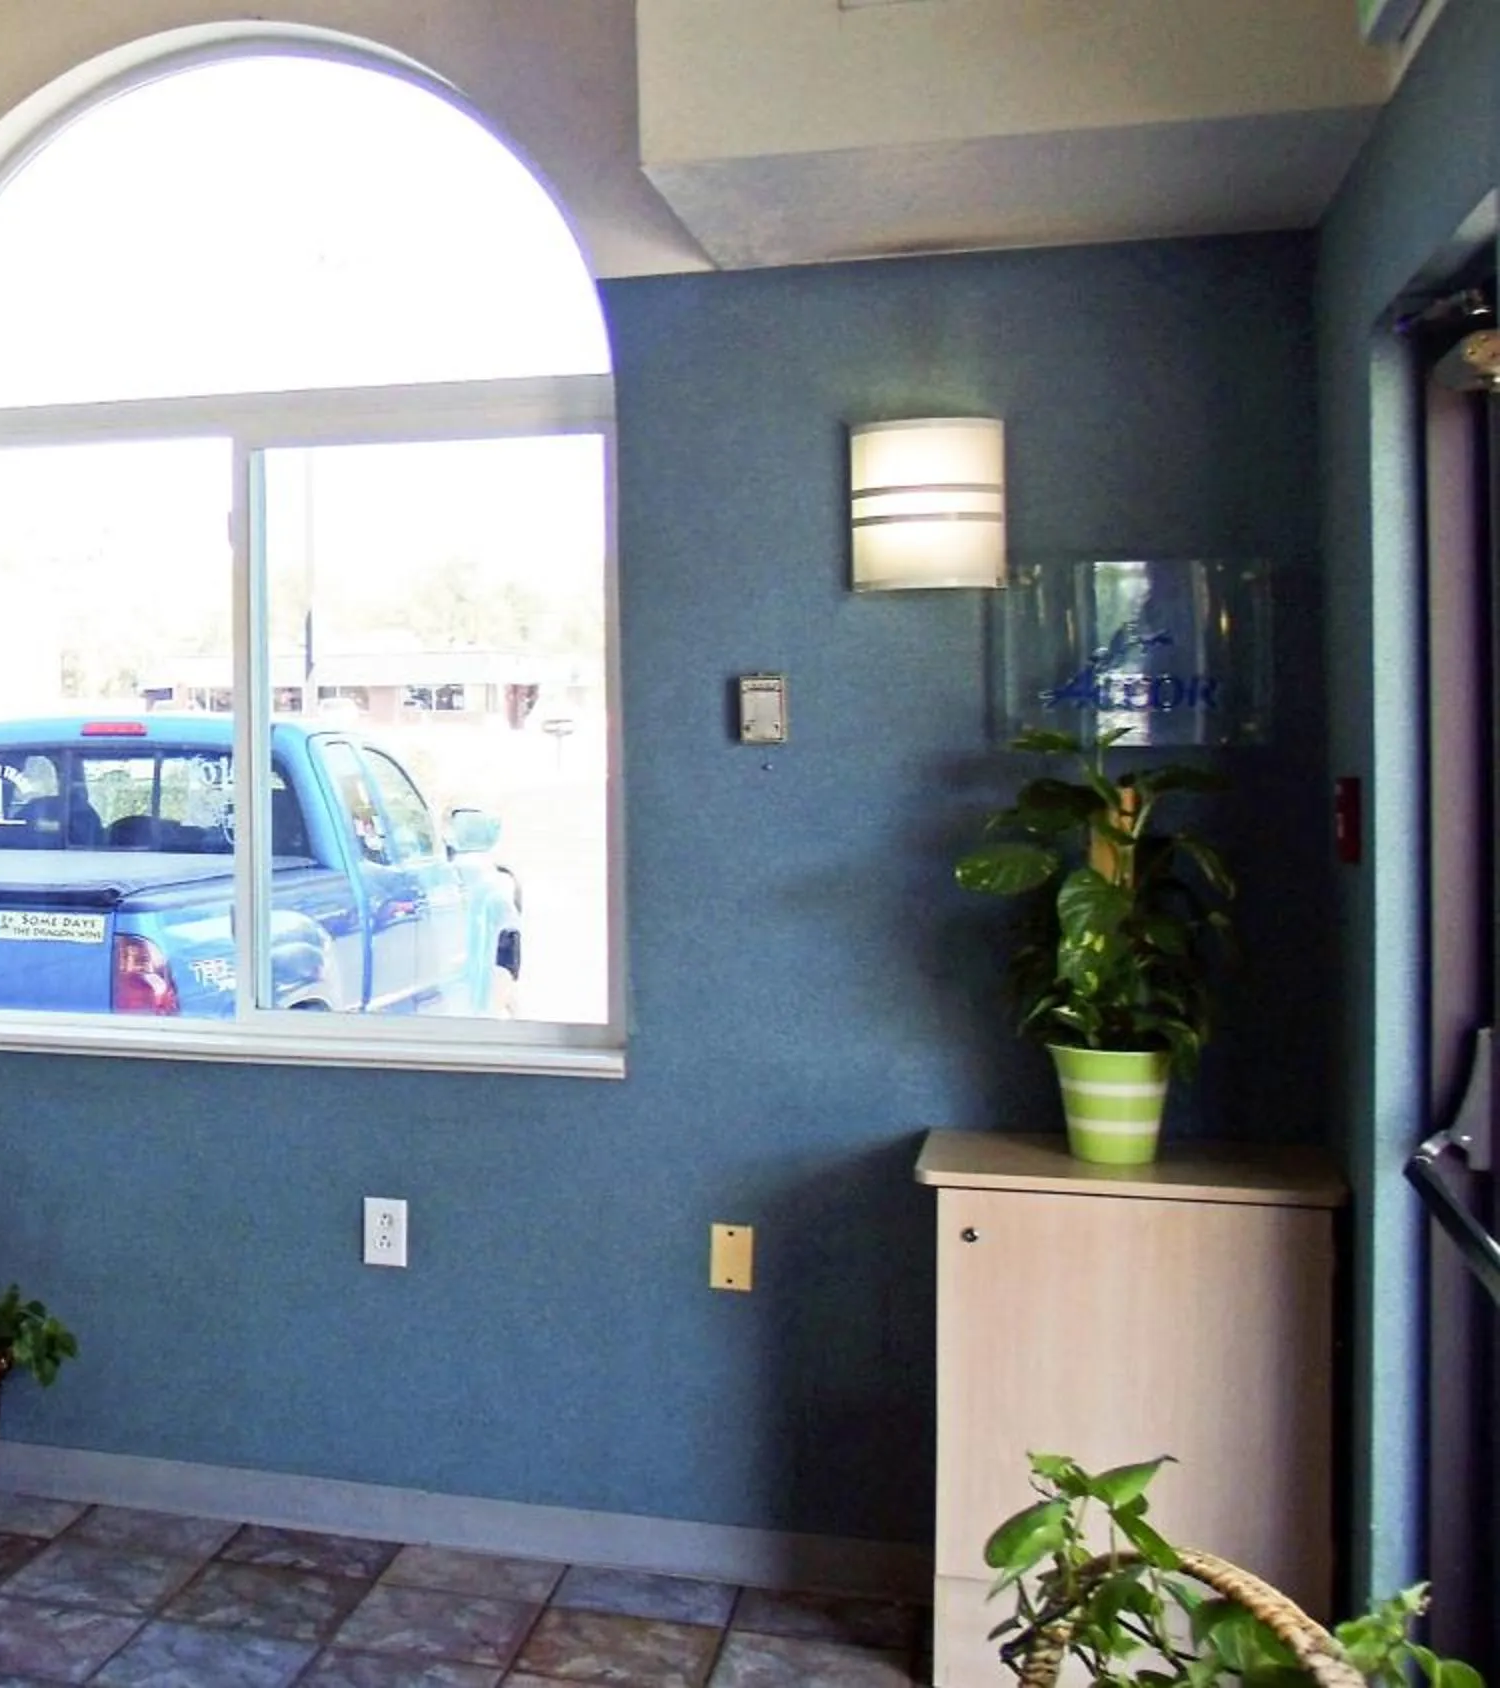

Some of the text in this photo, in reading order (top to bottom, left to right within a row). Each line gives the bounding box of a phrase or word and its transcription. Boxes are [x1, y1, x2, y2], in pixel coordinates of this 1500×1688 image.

[21, 914, 95, 928] SOME DAYS
[13, 927, 30, 937] THE
[33, 927, 75, 938] DRAGON
